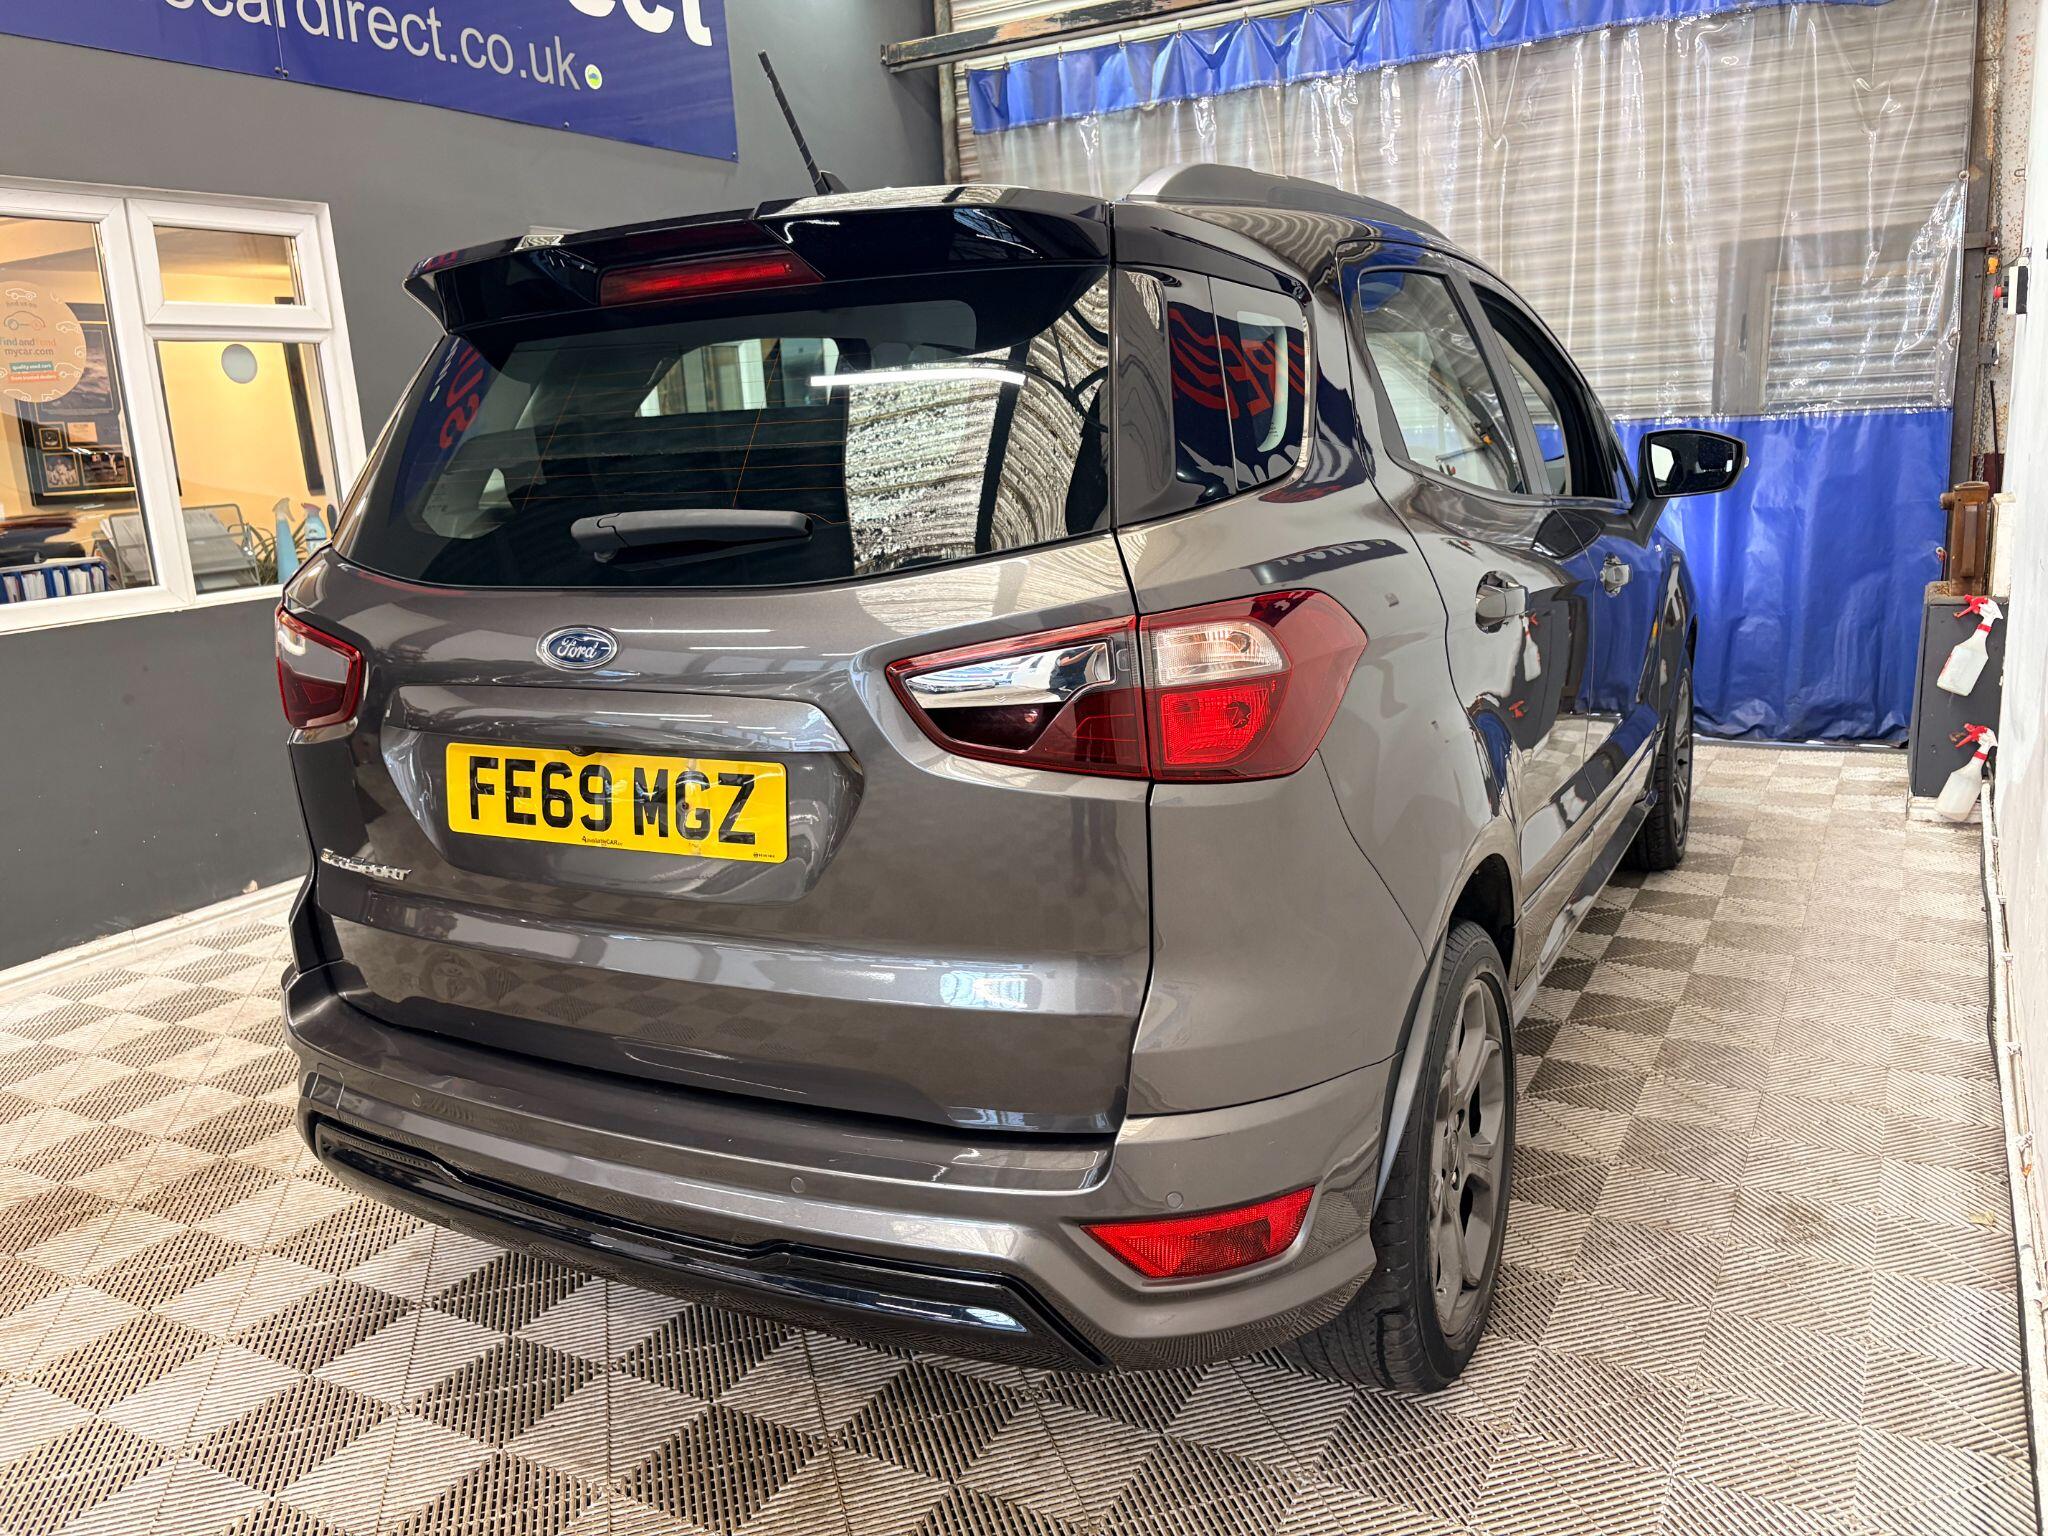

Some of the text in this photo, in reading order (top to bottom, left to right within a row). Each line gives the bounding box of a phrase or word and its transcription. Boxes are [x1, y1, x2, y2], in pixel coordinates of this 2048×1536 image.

[556, 636, 600, 659] Ford
[469, 755, 756, 846] FE69 MGZ
